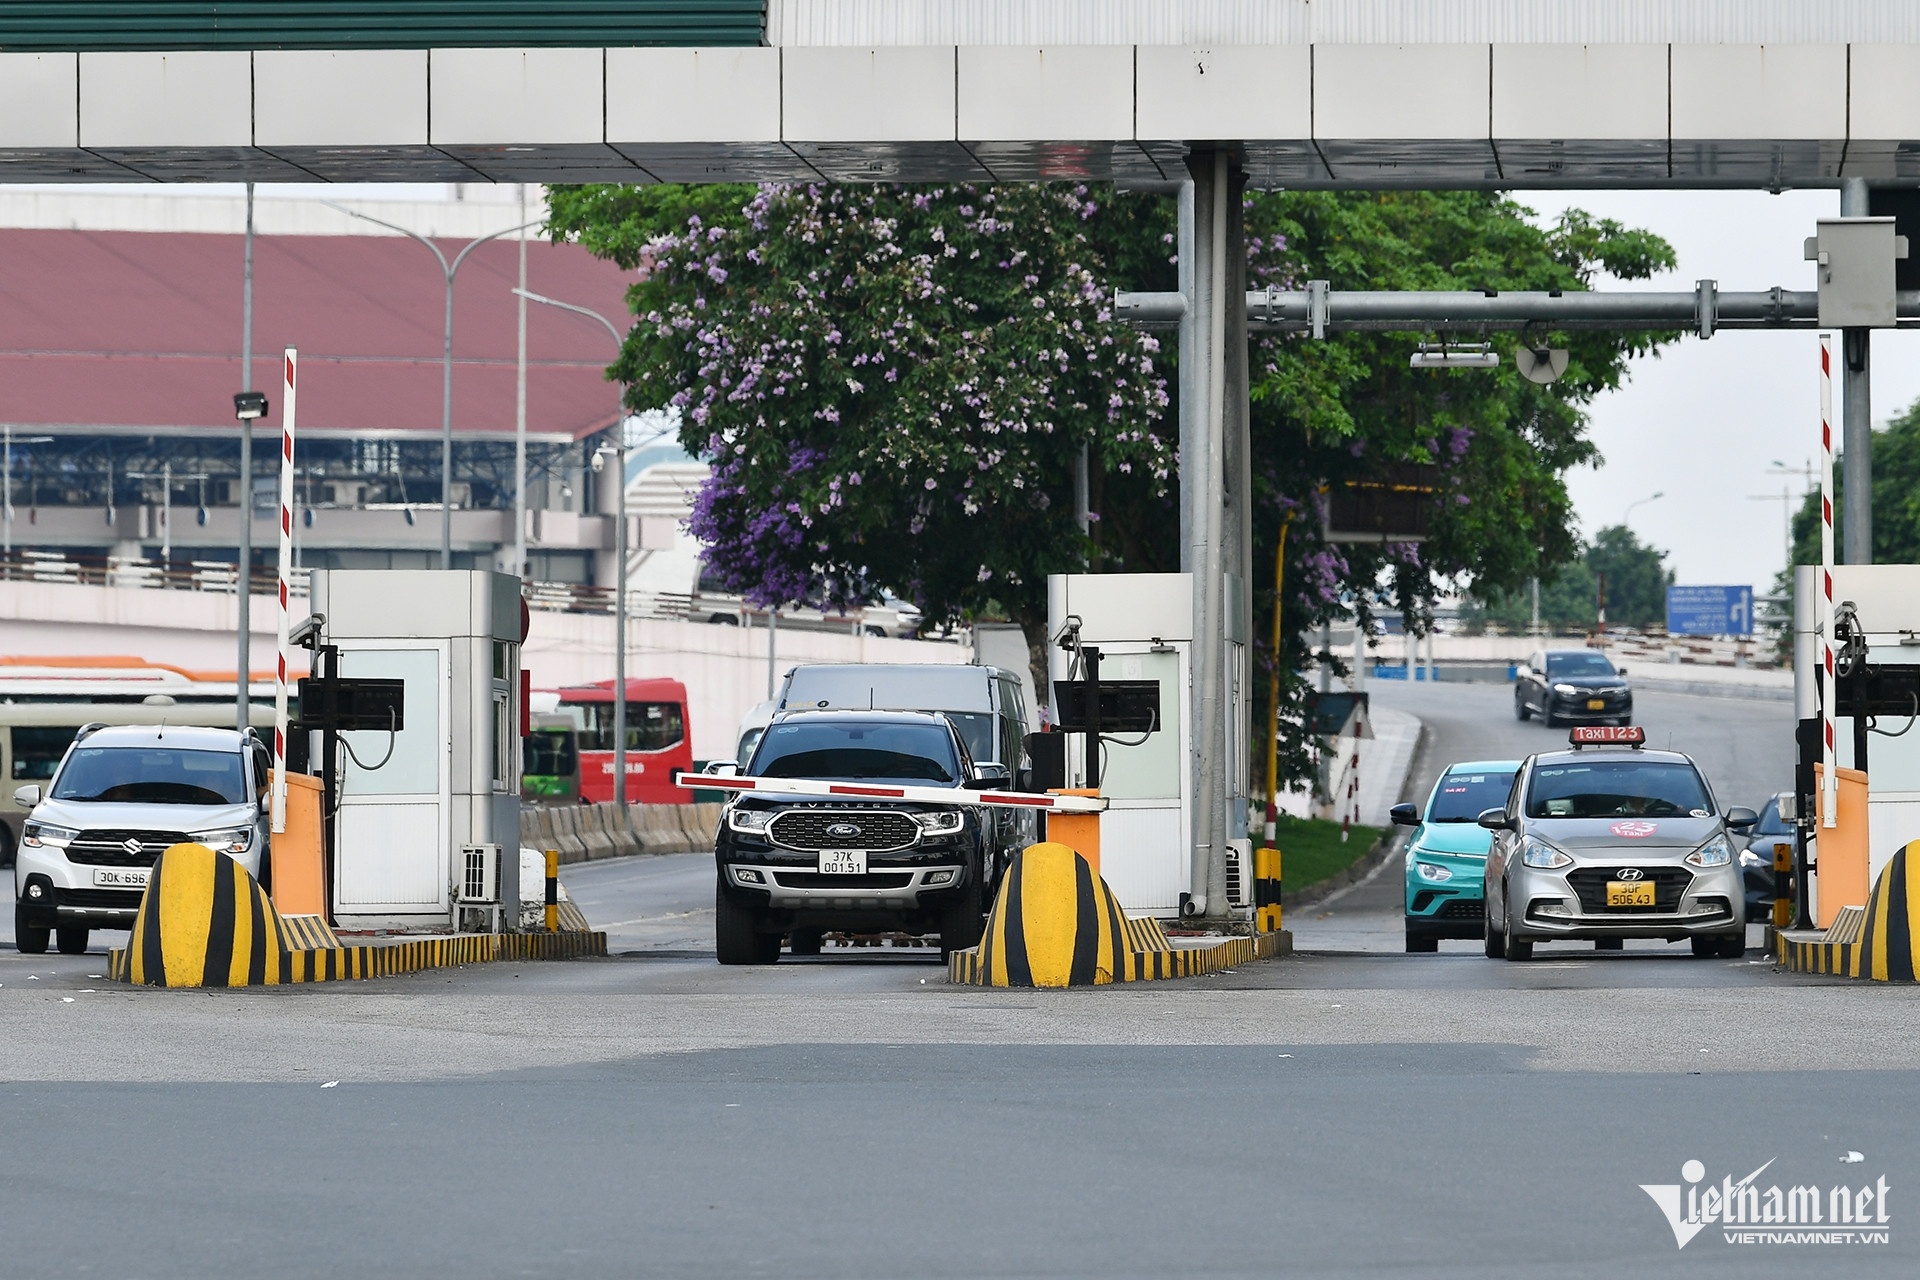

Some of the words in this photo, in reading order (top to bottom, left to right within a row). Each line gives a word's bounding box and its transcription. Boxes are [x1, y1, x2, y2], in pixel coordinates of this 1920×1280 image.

[1577, 727, 1605, 739] Taxi
[1608, 727, 1638, 739] 123
[1612, 822, 1657, 834] 123
[833, 852, 853, 862] 37K
[824, 863, 861, 873] 001.51
[100, 872, 148, 884] 30K-696.
[1621, 883, 1641, 894] 30F
[1612, 895, 1650, 905] 506.43
